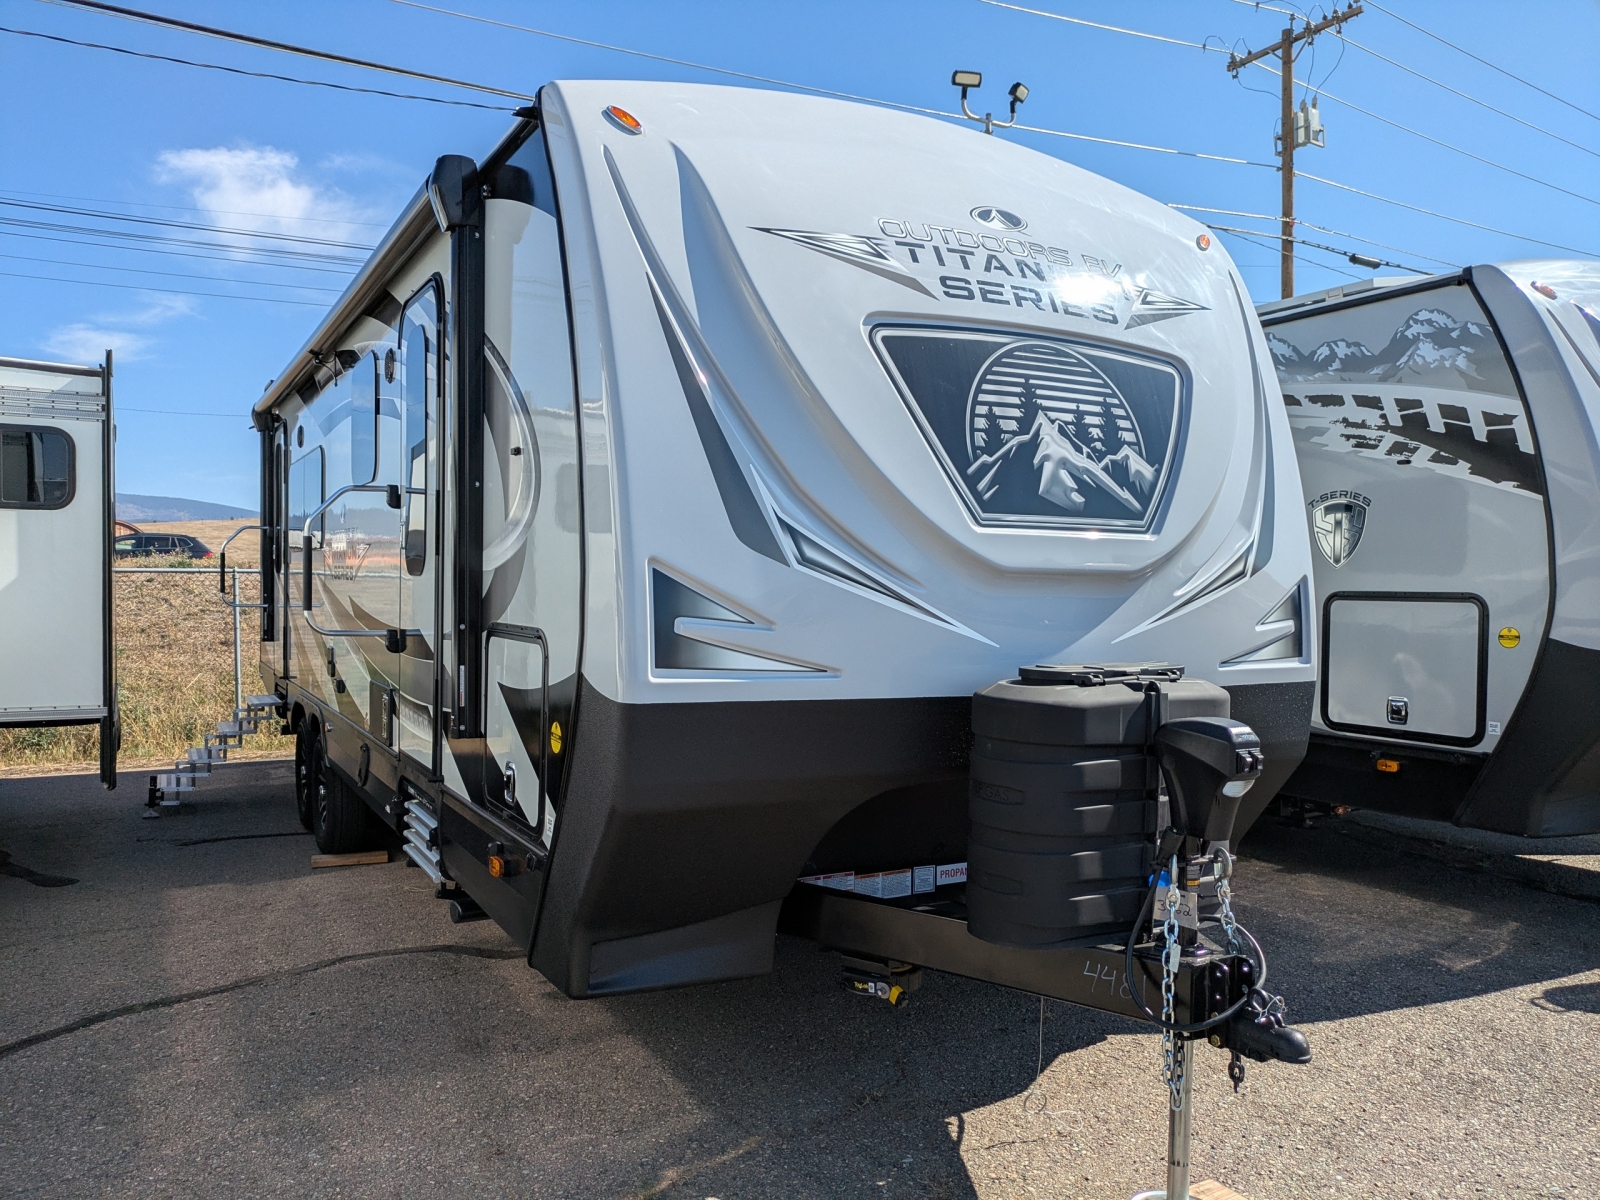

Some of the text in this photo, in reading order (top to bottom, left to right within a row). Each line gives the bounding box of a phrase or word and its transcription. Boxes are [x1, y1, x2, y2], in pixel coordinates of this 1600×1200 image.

[878, 218, 1122, 278] OUTDOORS RV
[894, 240, 1048, 282] TITAN
[939, 275, 1119, 325] SERIES
[1308, 489, 1372, 509] T-SERIES
[985, 785, 1010, 802] GAS
